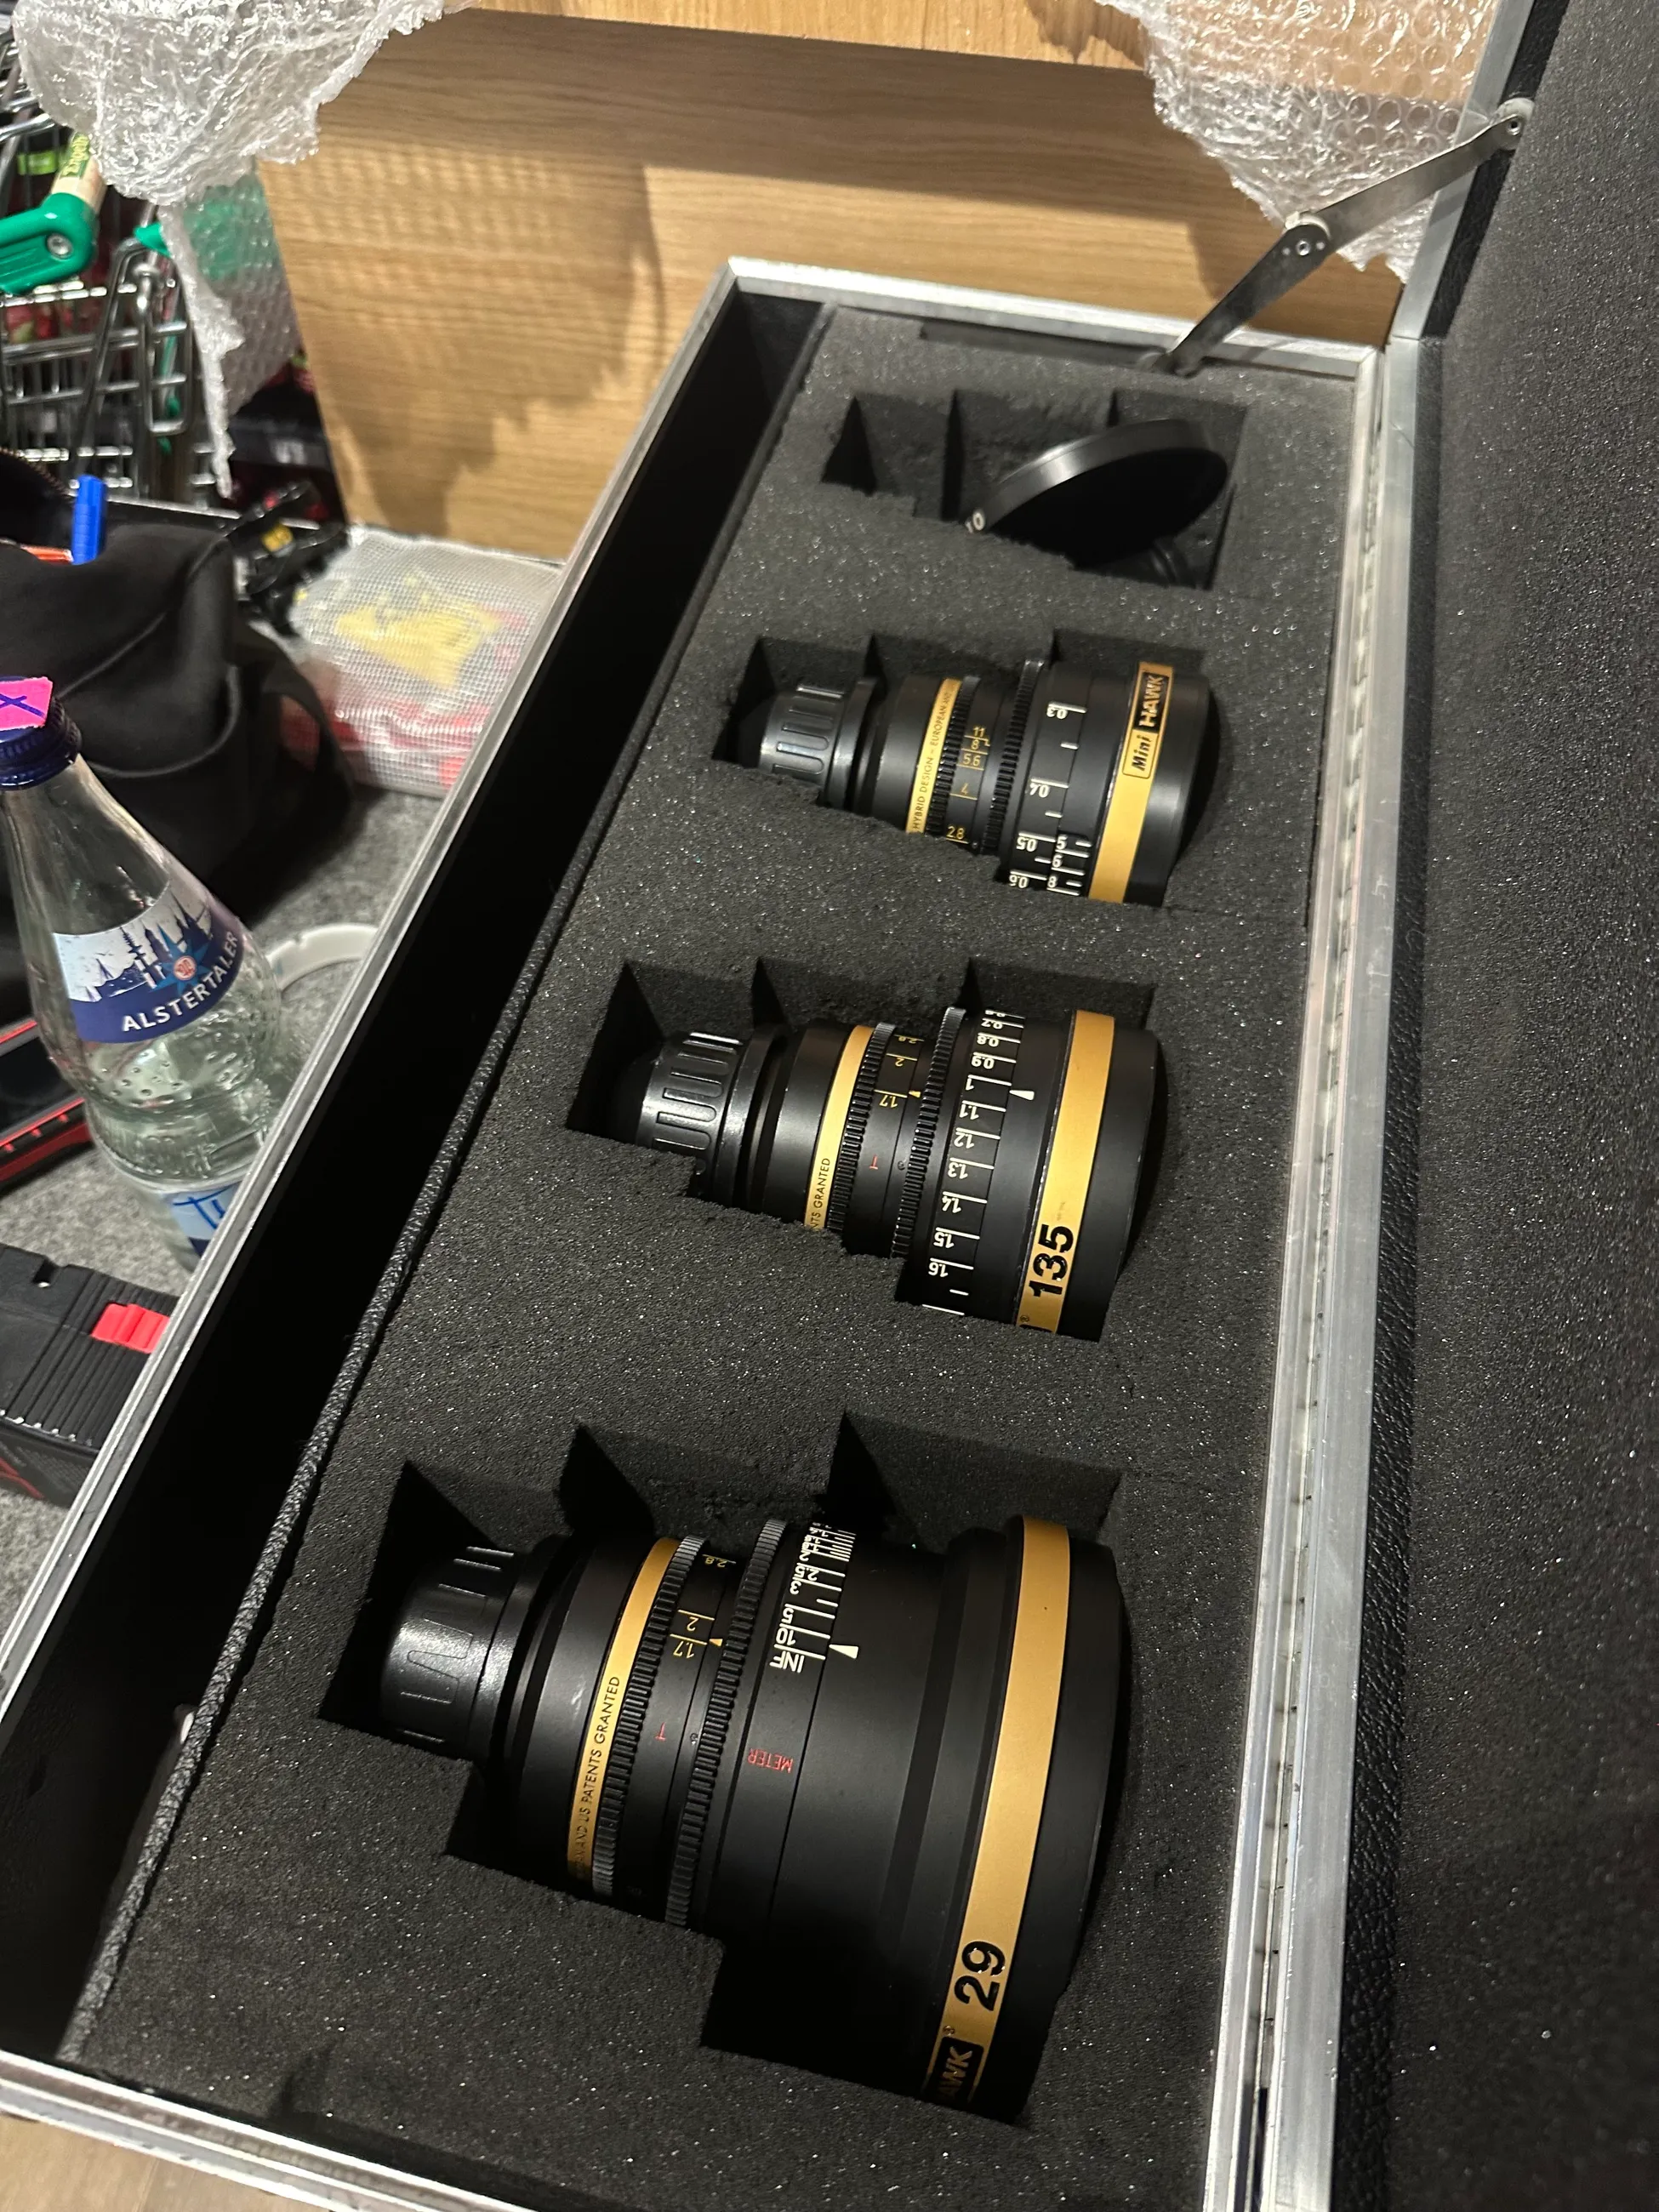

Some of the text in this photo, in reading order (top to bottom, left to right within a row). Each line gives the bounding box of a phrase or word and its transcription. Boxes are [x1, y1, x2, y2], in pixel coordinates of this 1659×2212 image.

[1132, 675, 1164, 771] Mini HAWK
[972, 727, 986, 738] 11
[971, 738, 979, 750] 8
[913, 795, 926, 830] HYBRID
[920, 757, 934, 793] DESIGN
[930, 706, 947, 747] EUROPEAN
[963, 755, 981, 767] 5.6
[961, 783, 968, 795] 4
[1056, 835, 1068, 850] 5
[1052, 854, 1063, 868] 6
[1047, 874, 1058, 888] 8
[122, 931, 238, 1032] ALSTERTALER
[895, 1057, 905, 1067] 2
[813, 1158, 830, 1208] GRANTED
[1029, 1223, 1074, 1297] 135
[790, 1580, 802, 1595] 3
[687, 1616, 700, 1632] 2
[781, 1607, 795, 1624] 5
[775, 1628, 796, 1645] 10
[769, 1650, 805, 1673] INF
[581, 1749, 601, 1804] PATENTS
[594, 1676, 620, 1744] GRANTED
[747, 1747, 794, 1774] METER
[955, 1941, 1006, 2011] 29
